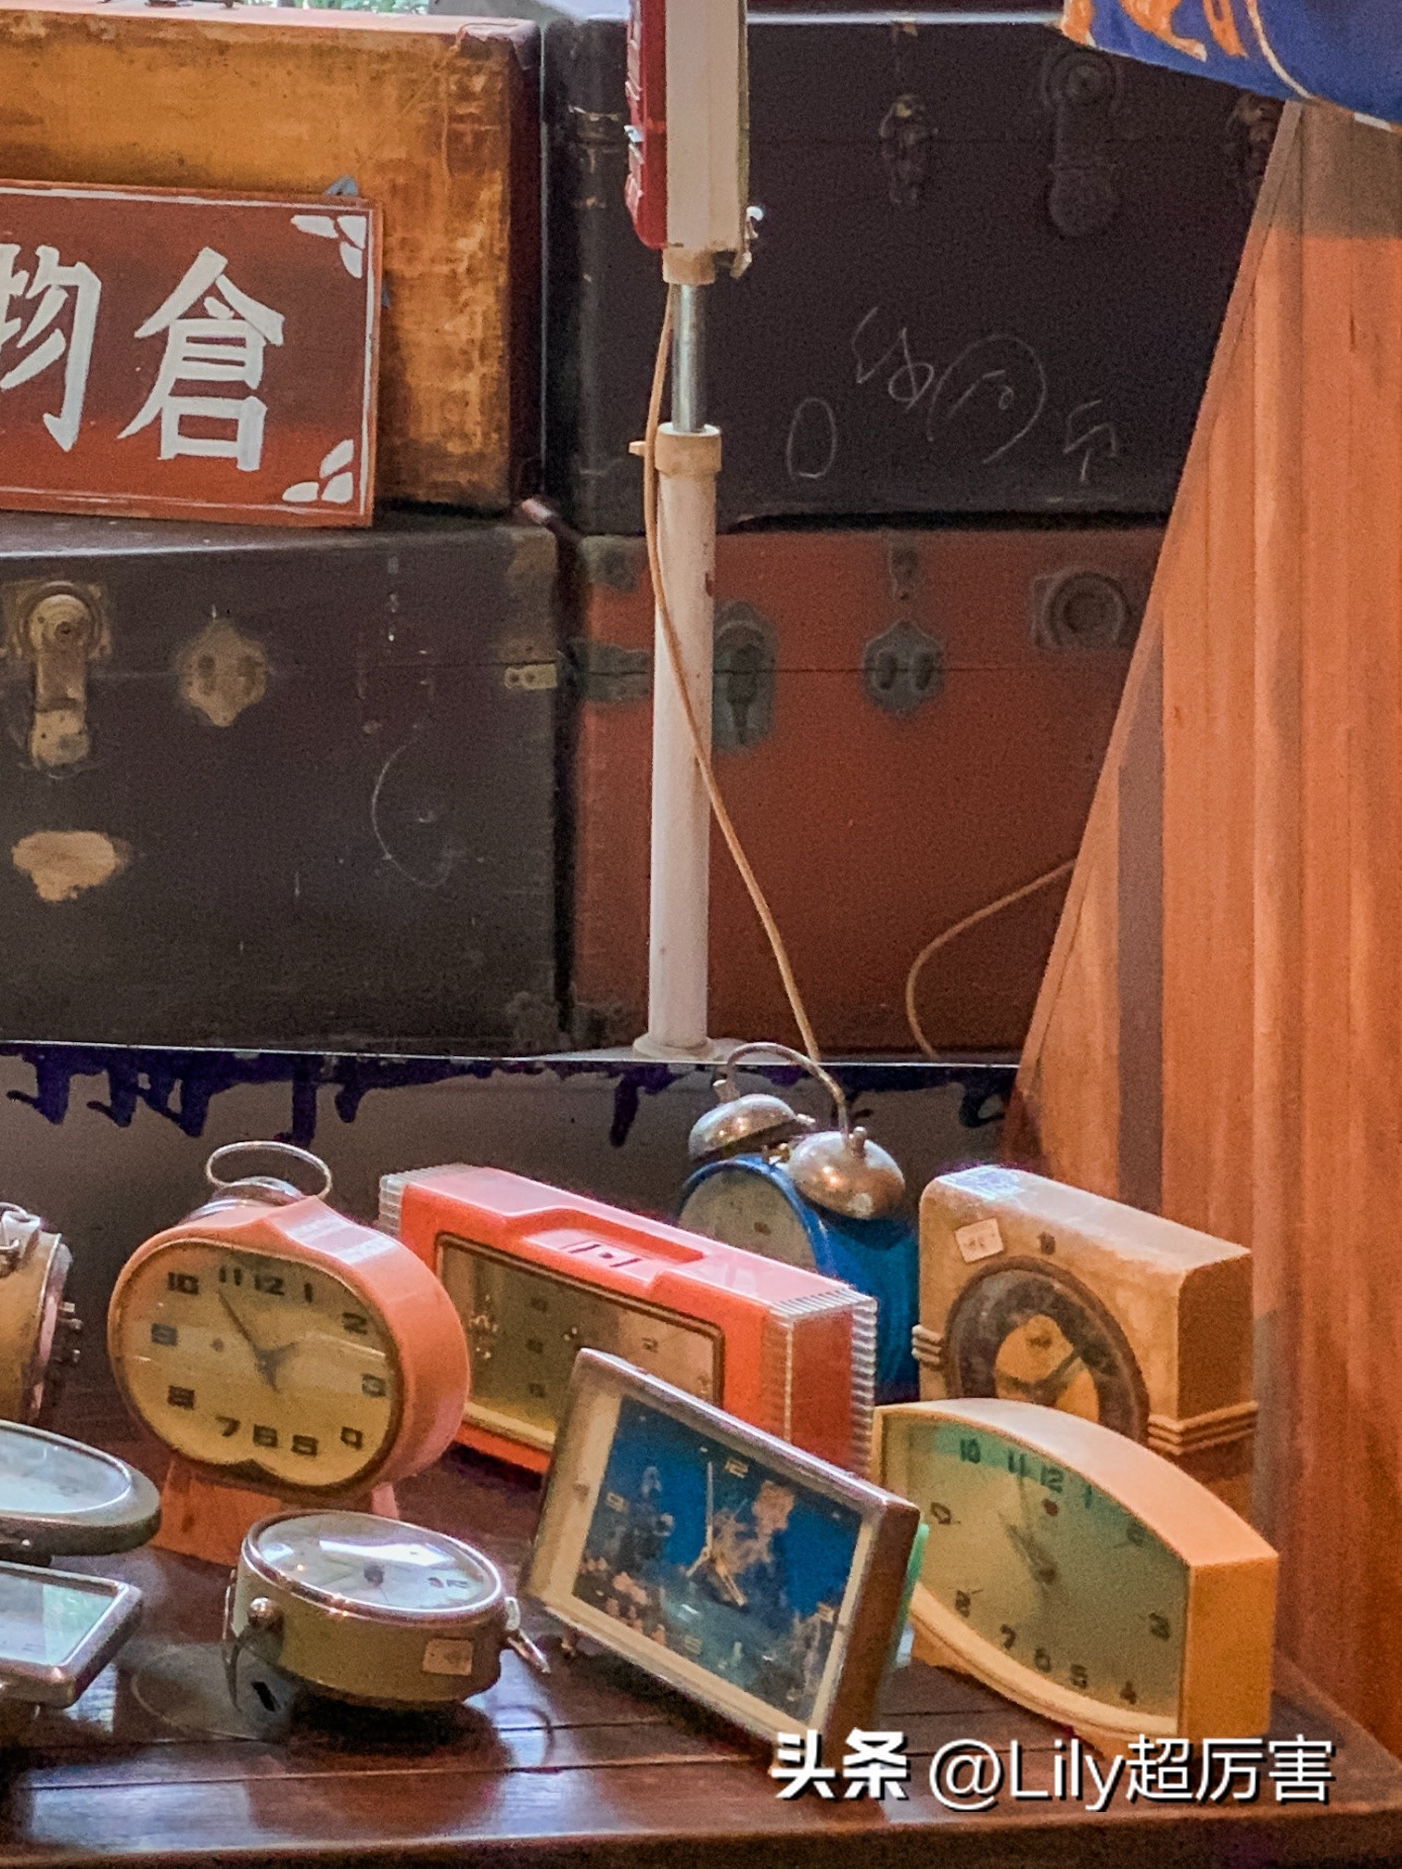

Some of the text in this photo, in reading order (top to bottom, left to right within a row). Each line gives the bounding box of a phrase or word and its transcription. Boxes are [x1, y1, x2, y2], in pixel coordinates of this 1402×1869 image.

[167, 1271, 200, 1295] 10
[219, 1264, 243, 1287] 11
[254, 1273, 285, 1296] 12
[303, 1282, 314, 1303] 1
[342, 1311, 368, 1335] 2
[215, 1415, 241, 1437] 7
[340, 1426, 364, 1450] 4
